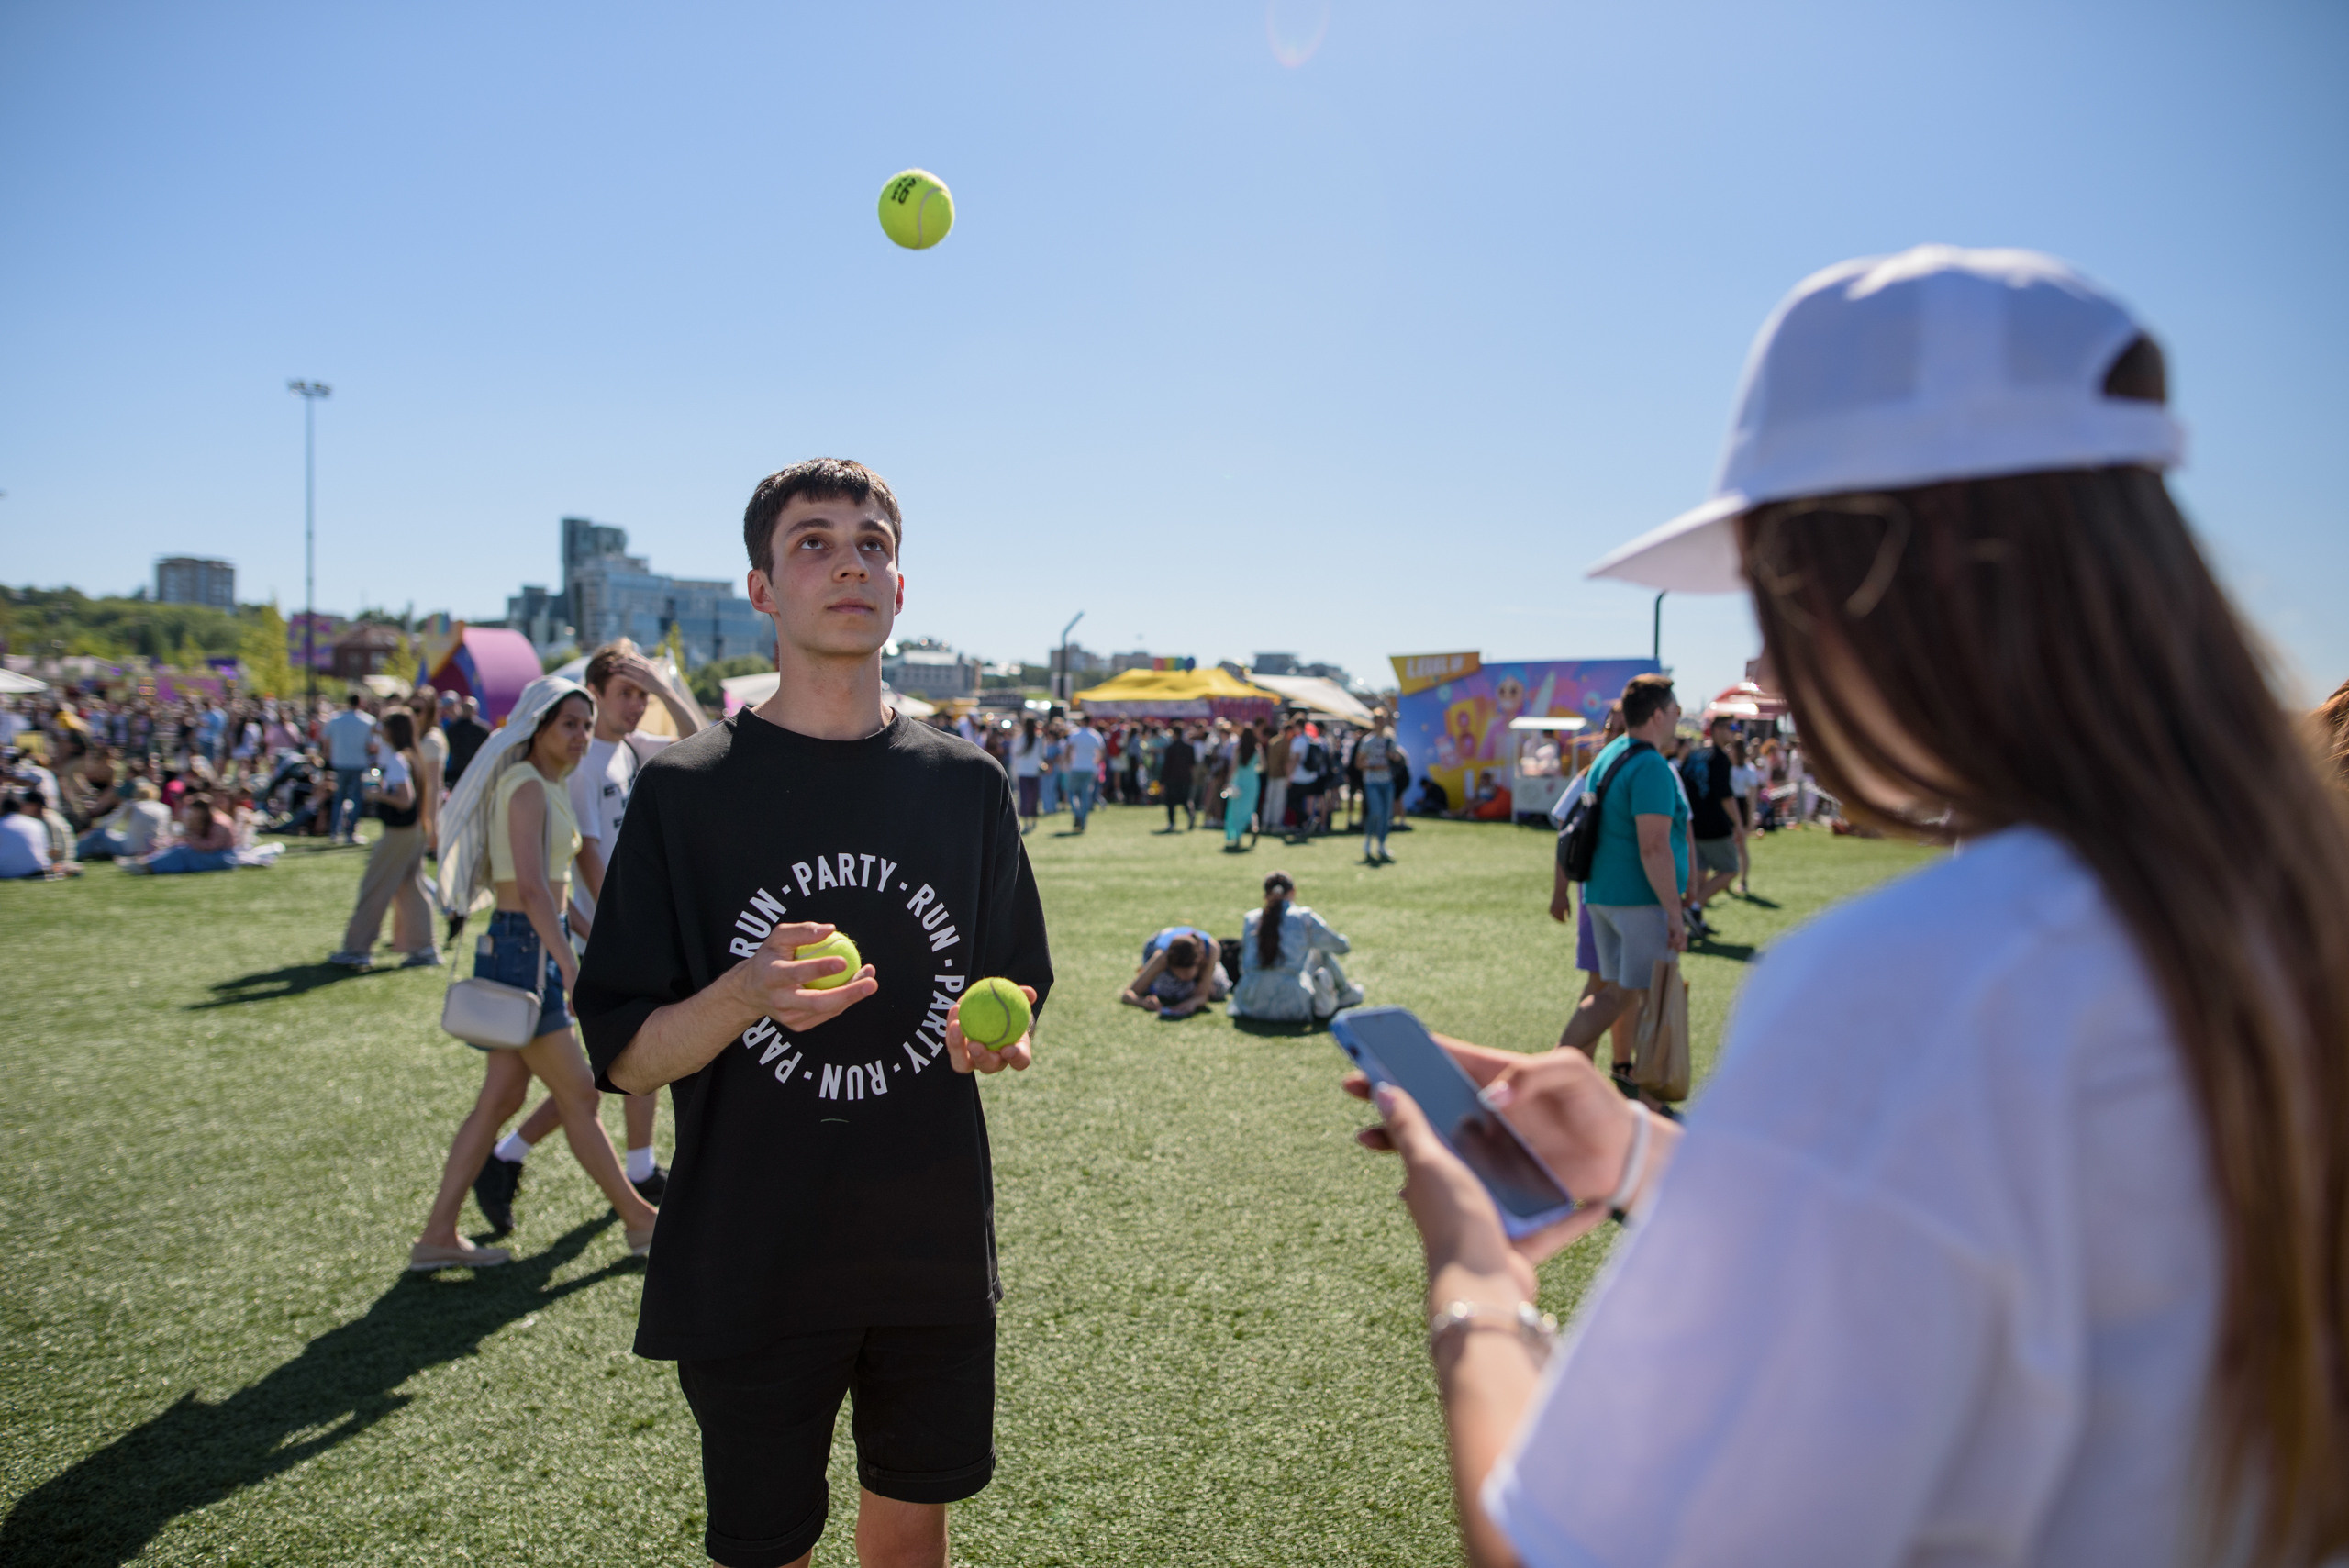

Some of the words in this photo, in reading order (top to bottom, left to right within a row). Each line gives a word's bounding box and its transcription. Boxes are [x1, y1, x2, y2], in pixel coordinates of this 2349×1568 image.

[791, 852, 897, 897] PARTY
[729, 887, 787, 959] RUN
[906, 883, 961, 952] RUN
[742, 1015, 803, 1084] PAR
[902, 974, 965, 1074] PARTY
[818, 1060, 888, 1101] RUN
